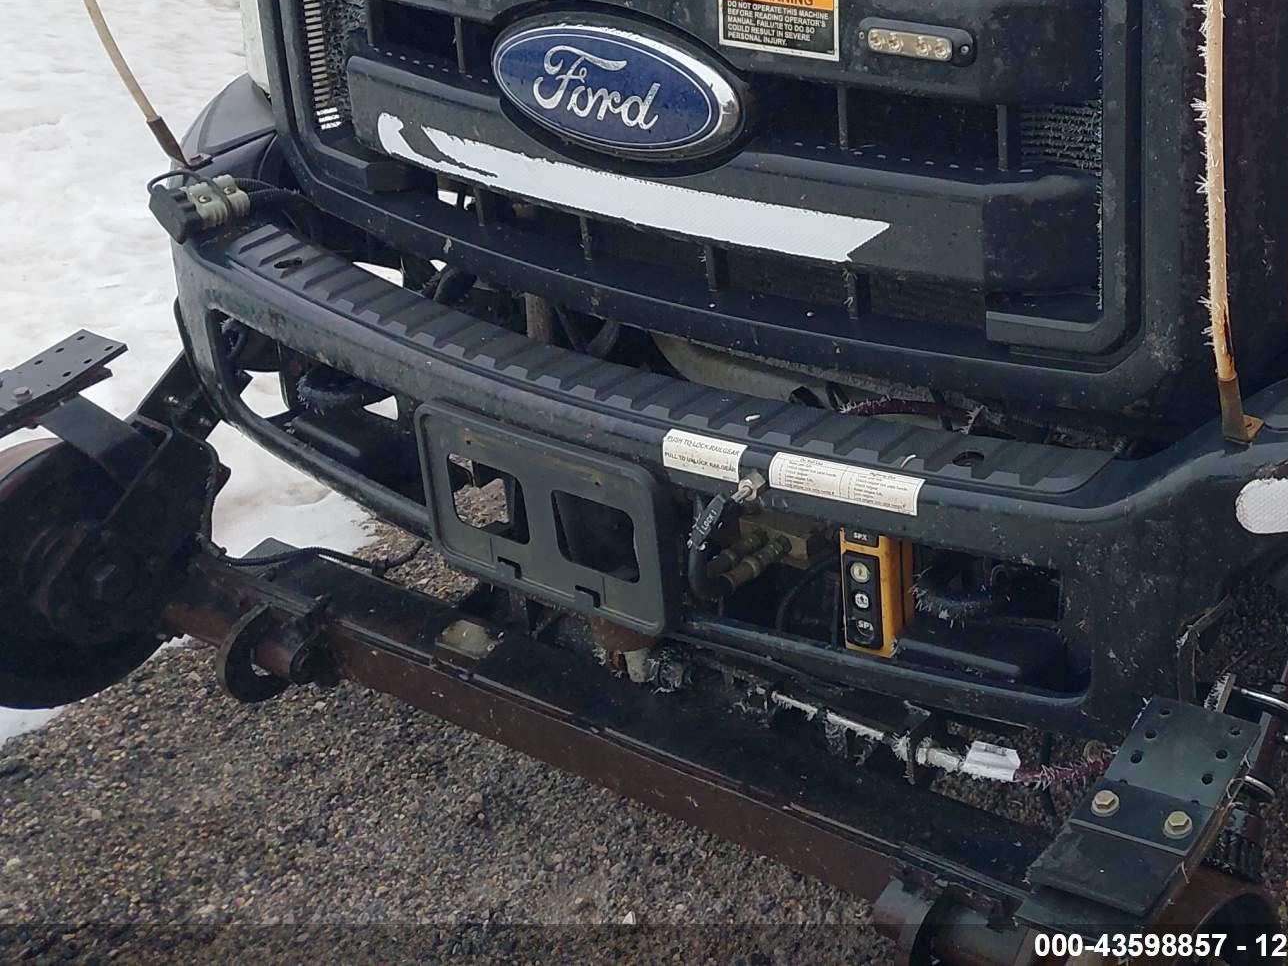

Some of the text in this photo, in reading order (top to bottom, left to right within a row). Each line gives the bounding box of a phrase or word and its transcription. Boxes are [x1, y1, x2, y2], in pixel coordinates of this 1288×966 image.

[727, 8, 826, 28] BEFORE READING OPERATOR'S
[738, 1, 751, 10] NOT
[752, 3, 782, 14] OPERATE
[783, 6, 798, 16] THIS
[799, 9, 829, 20] MACHINE
[727, 23, 750, 32] COULD
[751, 26, 775, 36] RESULT
[784, 31, 811, 42] SEVERE
[757, 19, 783, 30] FAILURE
[784, 23, 793, 31] TO
[794, 24, 804, 32] DO
[805, 26, 815, 34] SO
[727, 31, 762, 43] PERSONAL
[533, 44, 662, 131] Ford
[667, 435, 683, 444] PUSH
[692, 441, 708, 450] LOCK
